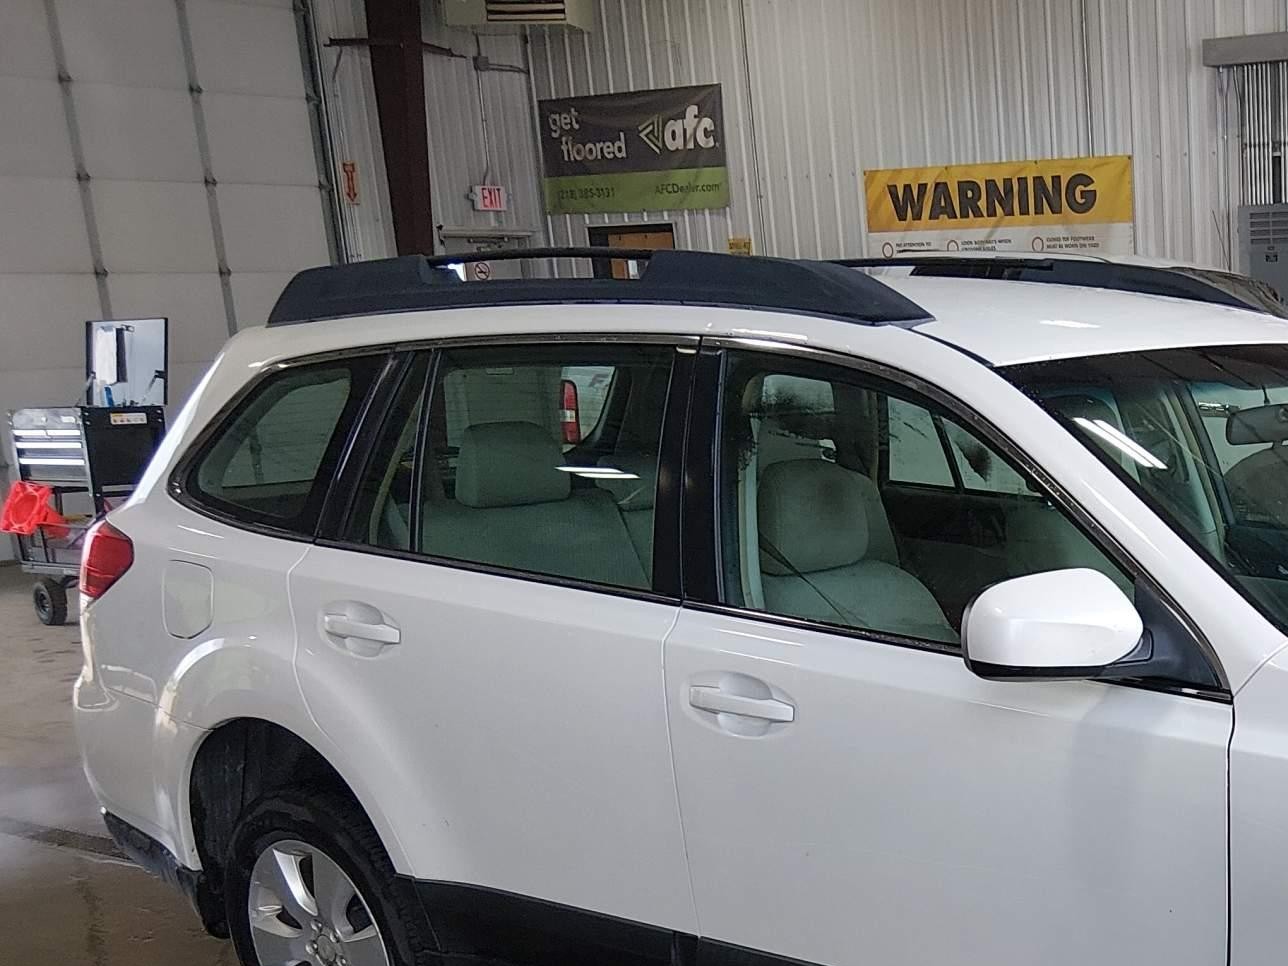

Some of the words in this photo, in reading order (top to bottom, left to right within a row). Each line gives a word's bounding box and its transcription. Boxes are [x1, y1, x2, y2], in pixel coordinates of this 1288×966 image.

[549, 107, 580, 138] get
[663, 104, 716, 152] afc
[560, 132, 628, 162] floored
[480, 187, 503, 209] EXIT
[886, 172, 1098, 222] WARNING
